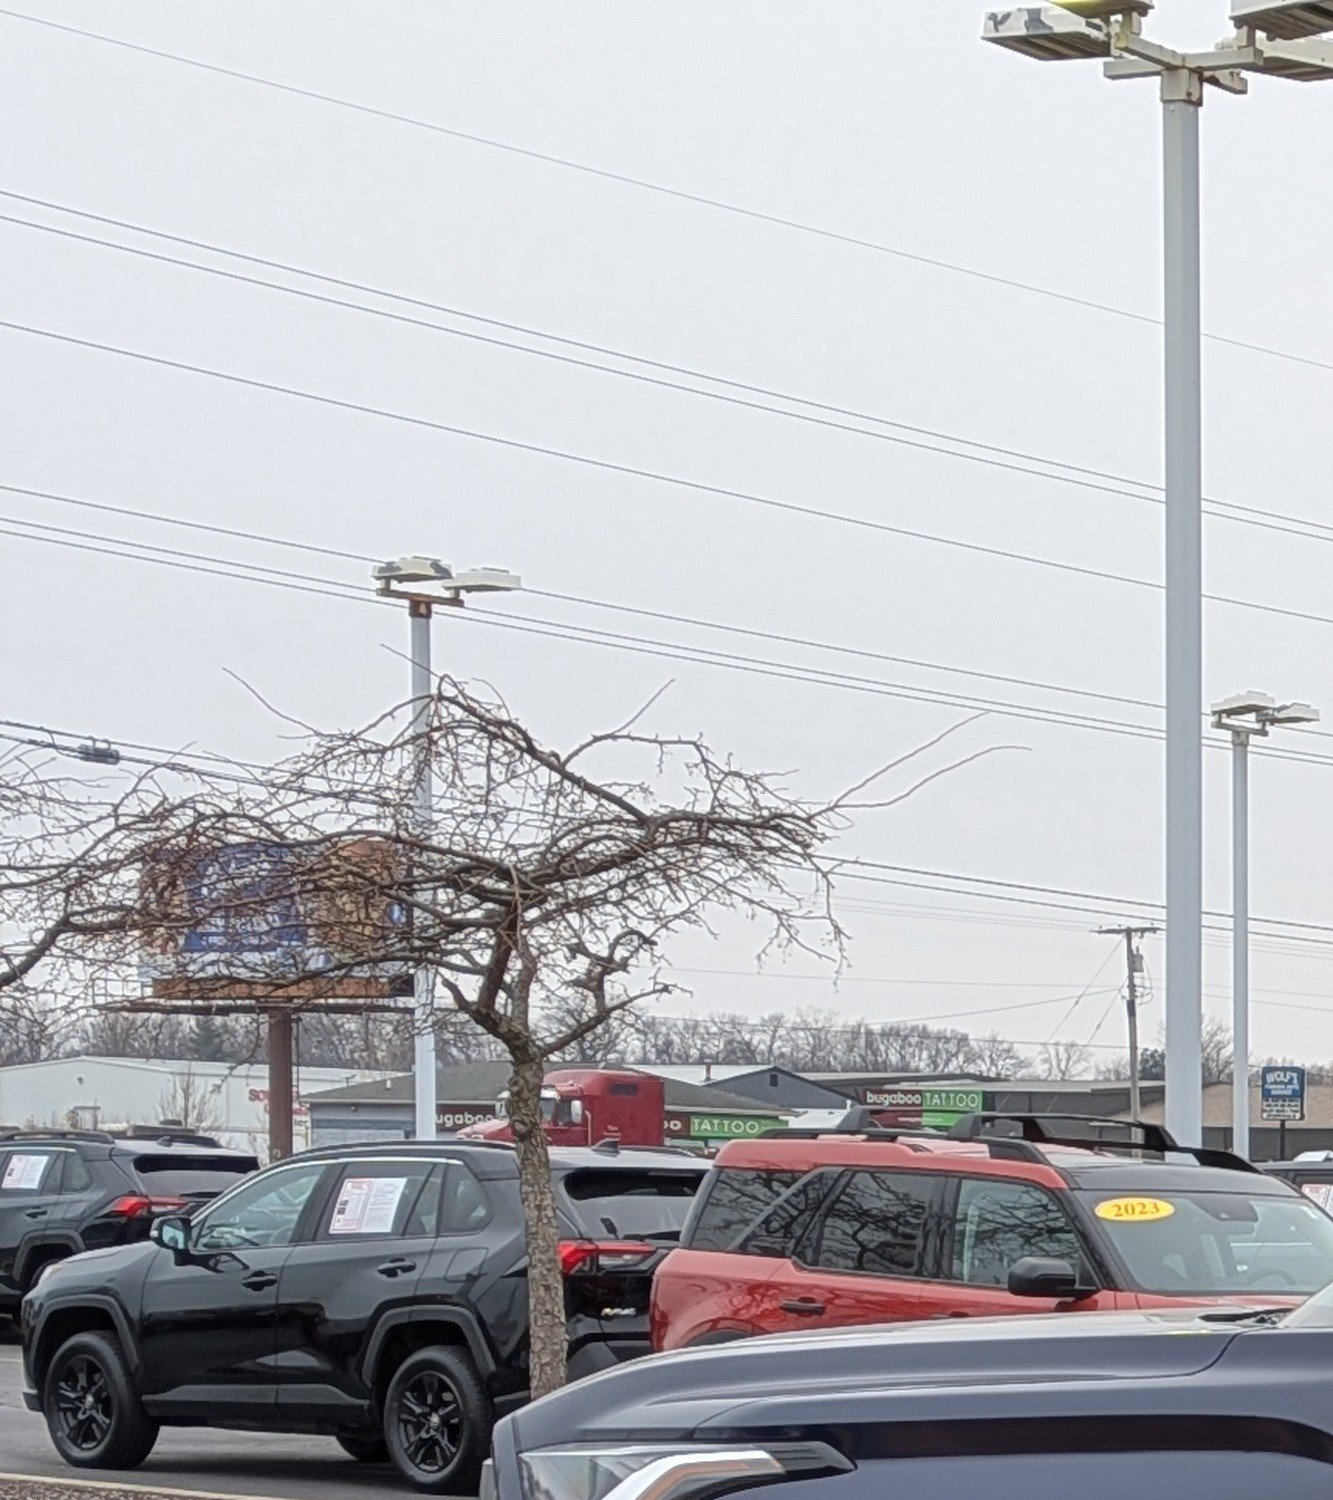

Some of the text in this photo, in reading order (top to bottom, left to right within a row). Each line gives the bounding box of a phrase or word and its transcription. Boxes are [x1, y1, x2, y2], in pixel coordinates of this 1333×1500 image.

[866, 1090, 979, 1107] bugaboo TATTOO
[436, 1111, 494, 1127] ugaboo
[692, 1119, 760, 1134] TATTOO
[1111, 1202, 1160, 1217] 2023
